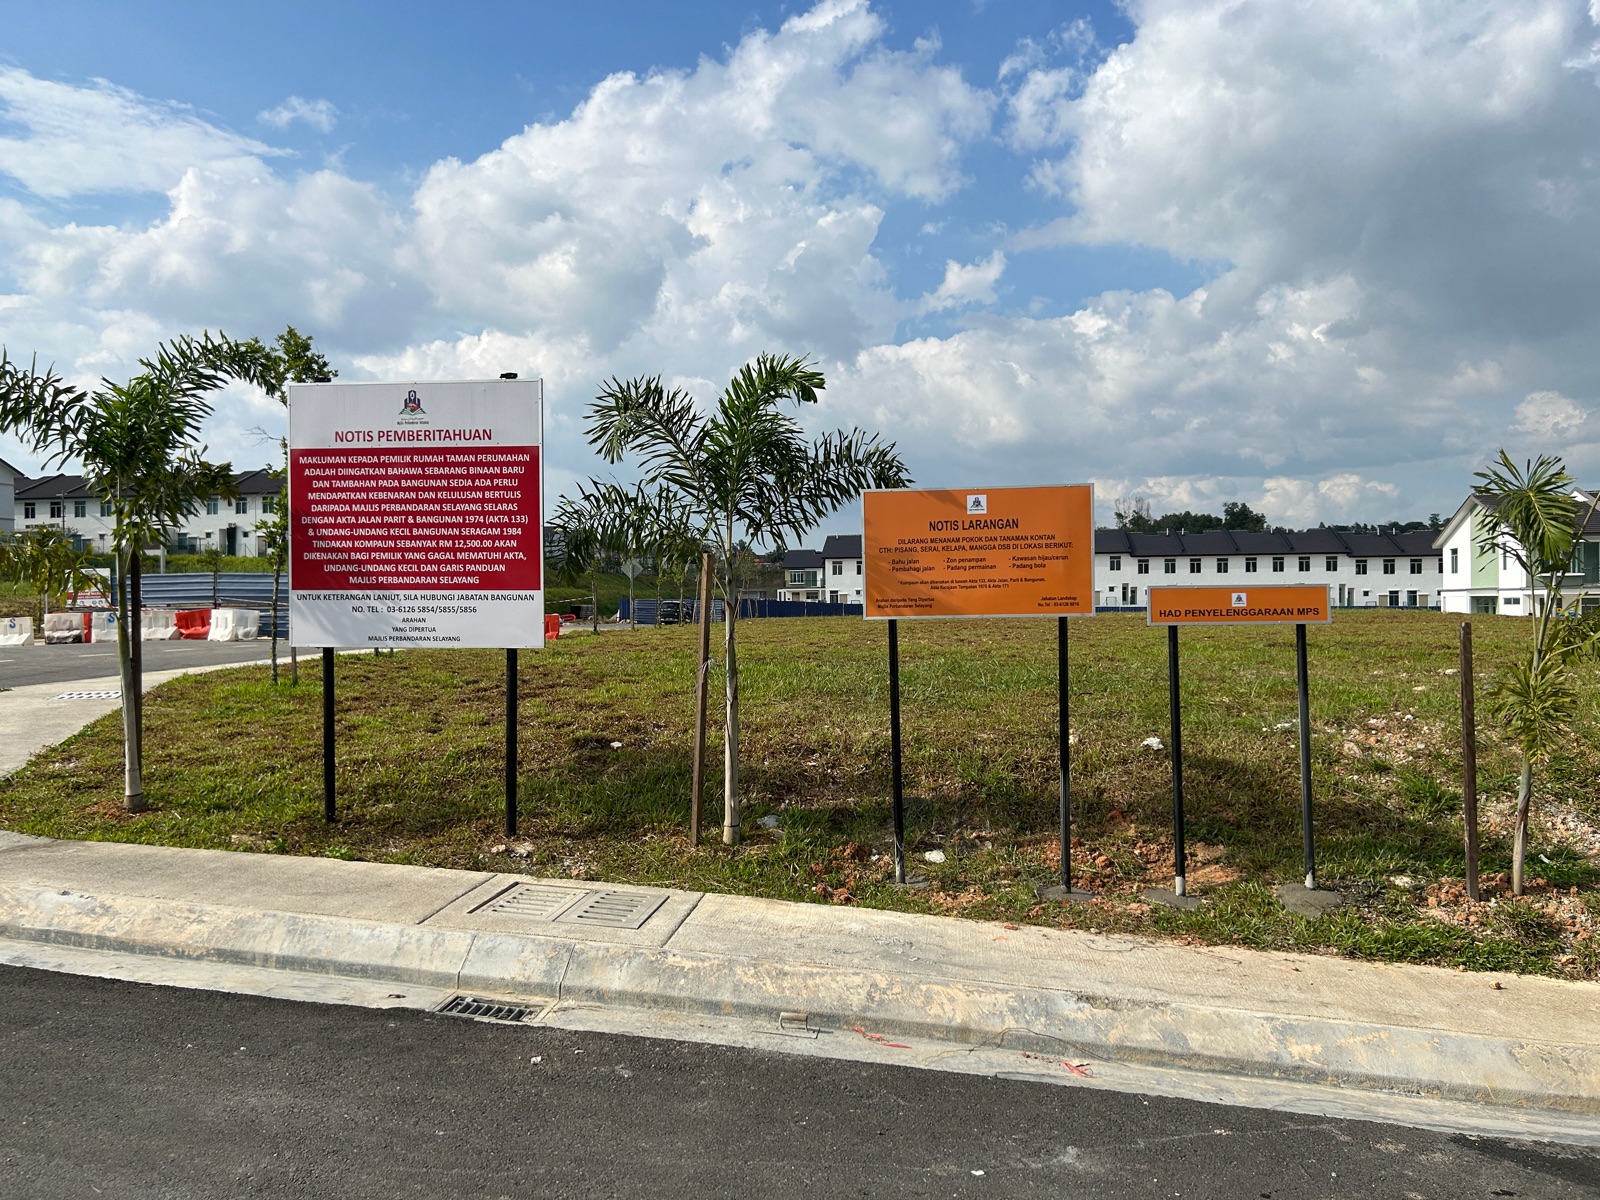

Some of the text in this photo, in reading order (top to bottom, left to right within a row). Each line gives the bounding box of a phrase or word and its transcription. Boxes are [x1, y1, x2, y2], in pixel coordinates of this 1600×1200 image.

[335, 429, 491, 441] NOTIS PEMBERITAHUAN
[485, 515, 509, 524] (AKTA
[511, 514, 528, 523] 133)
[929, 518, 1018, 530] NOTIS LARANGAN
[454, 539, 492, 548] 12,500.00
[503, 551, 526, 560] AKTA,
[417, 606, 477, 614] 5854/5855/5856
